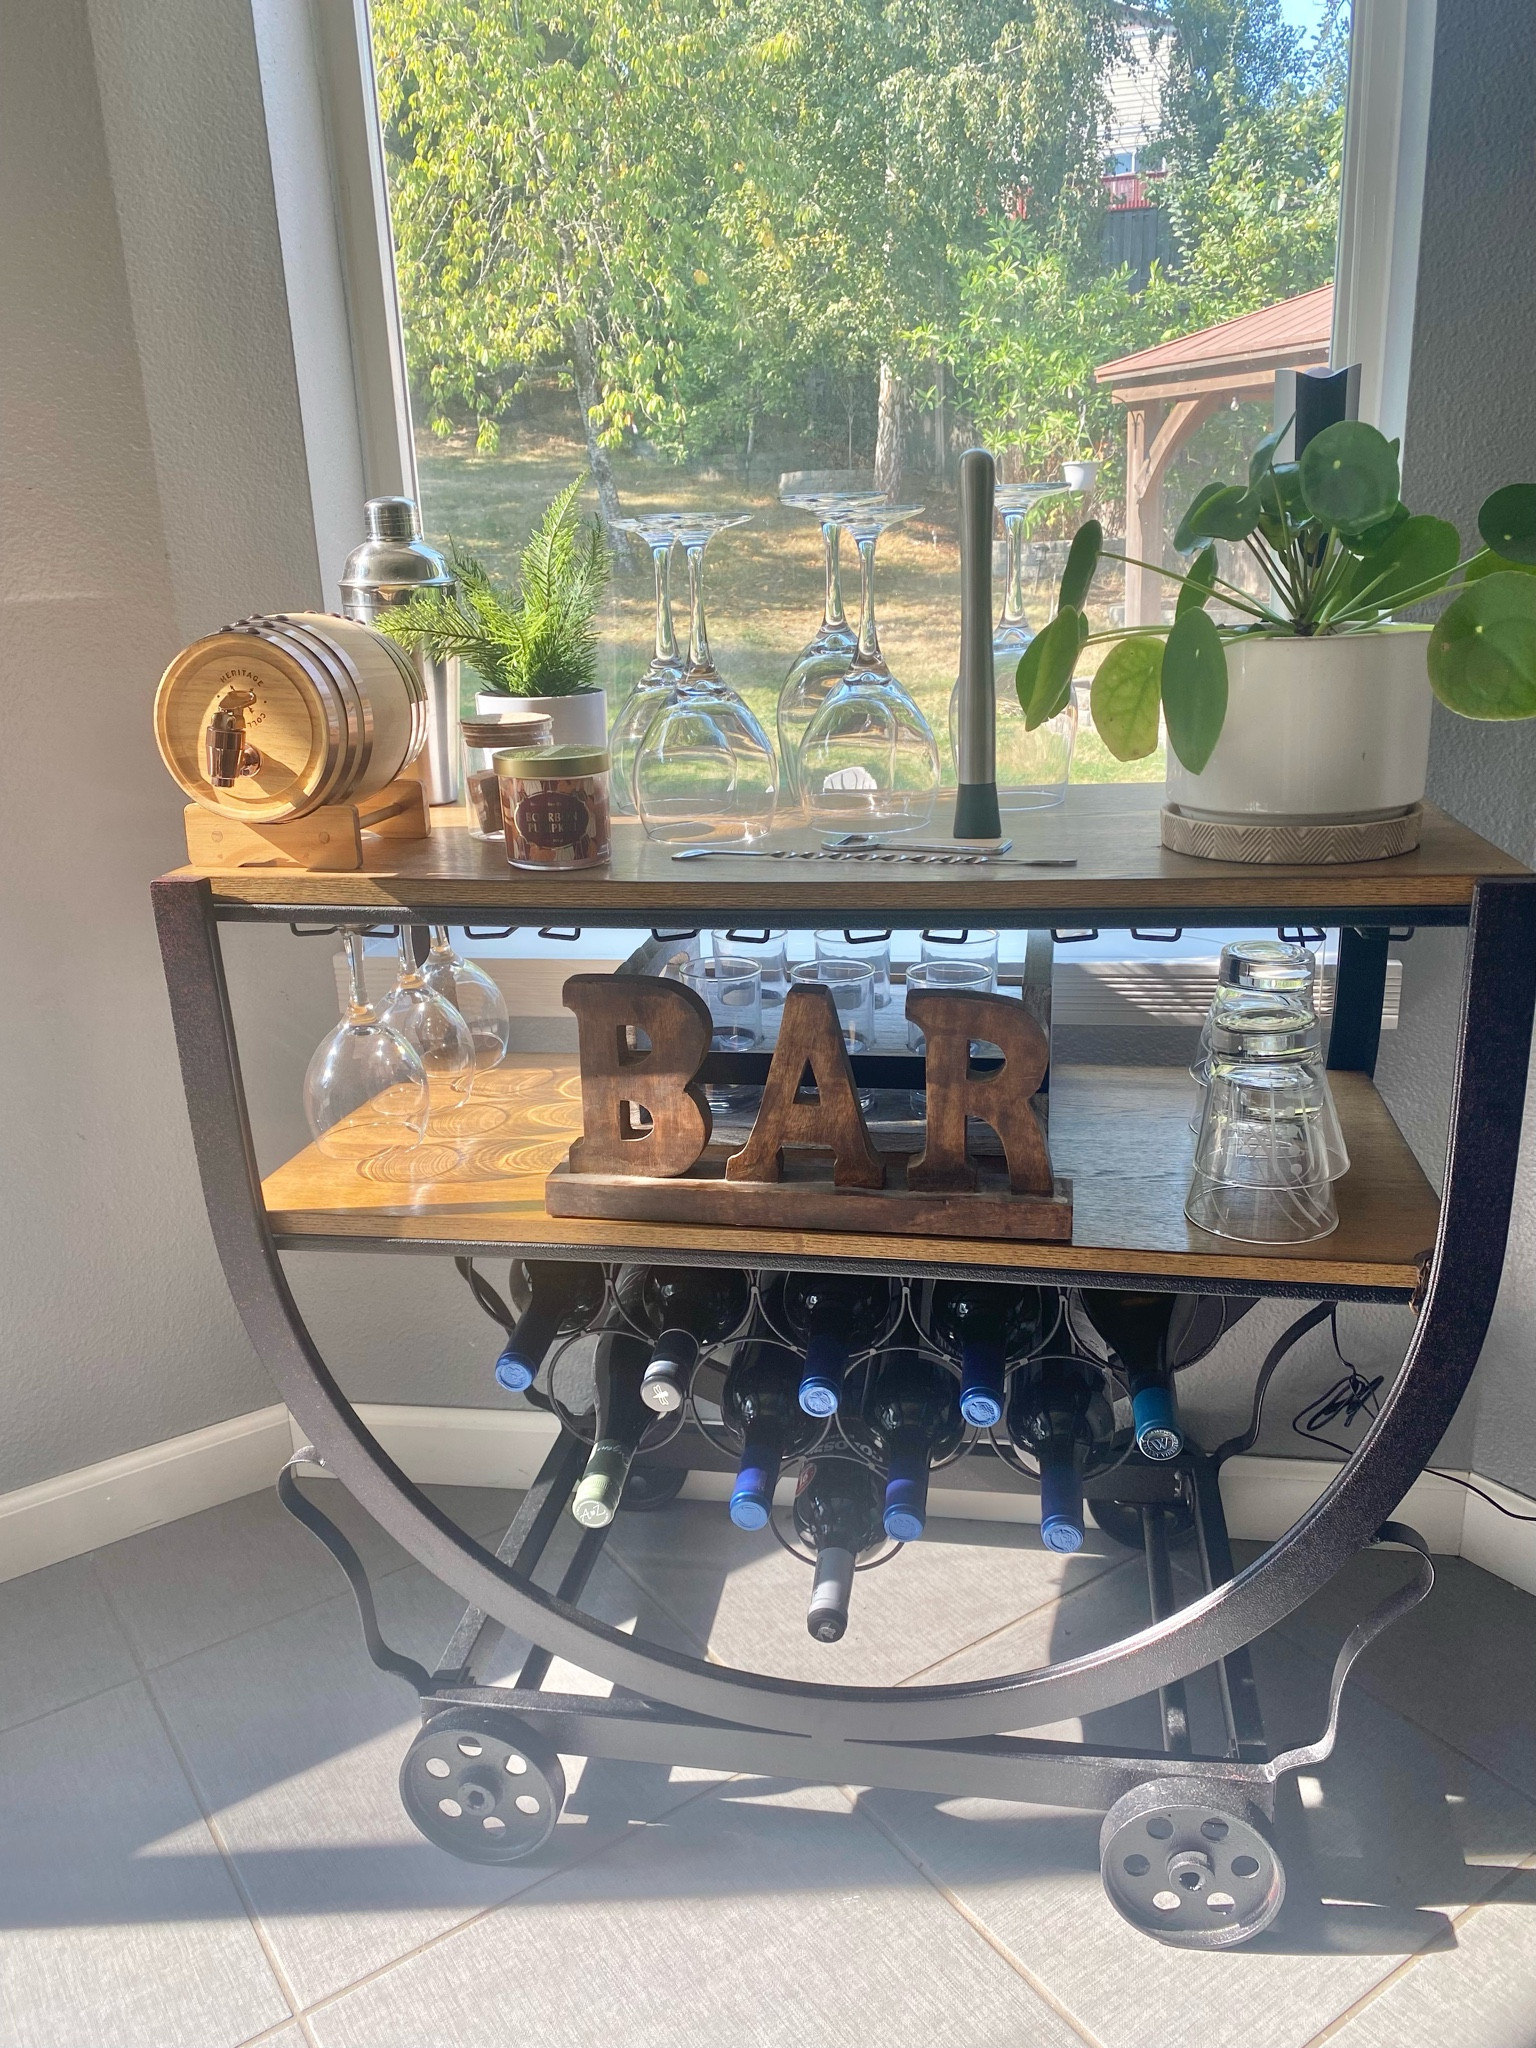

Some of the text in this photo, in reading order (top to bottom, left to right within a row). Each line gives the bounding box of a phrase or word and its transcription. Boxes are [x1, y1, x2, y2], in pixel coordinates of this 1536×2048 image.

[220, 669, 264, 687] HERITAGE
[246, 712, 266, 728] COLL
[525, 812, 578, 822] BORBN
[563, 973, 1054, 1197] BAR
